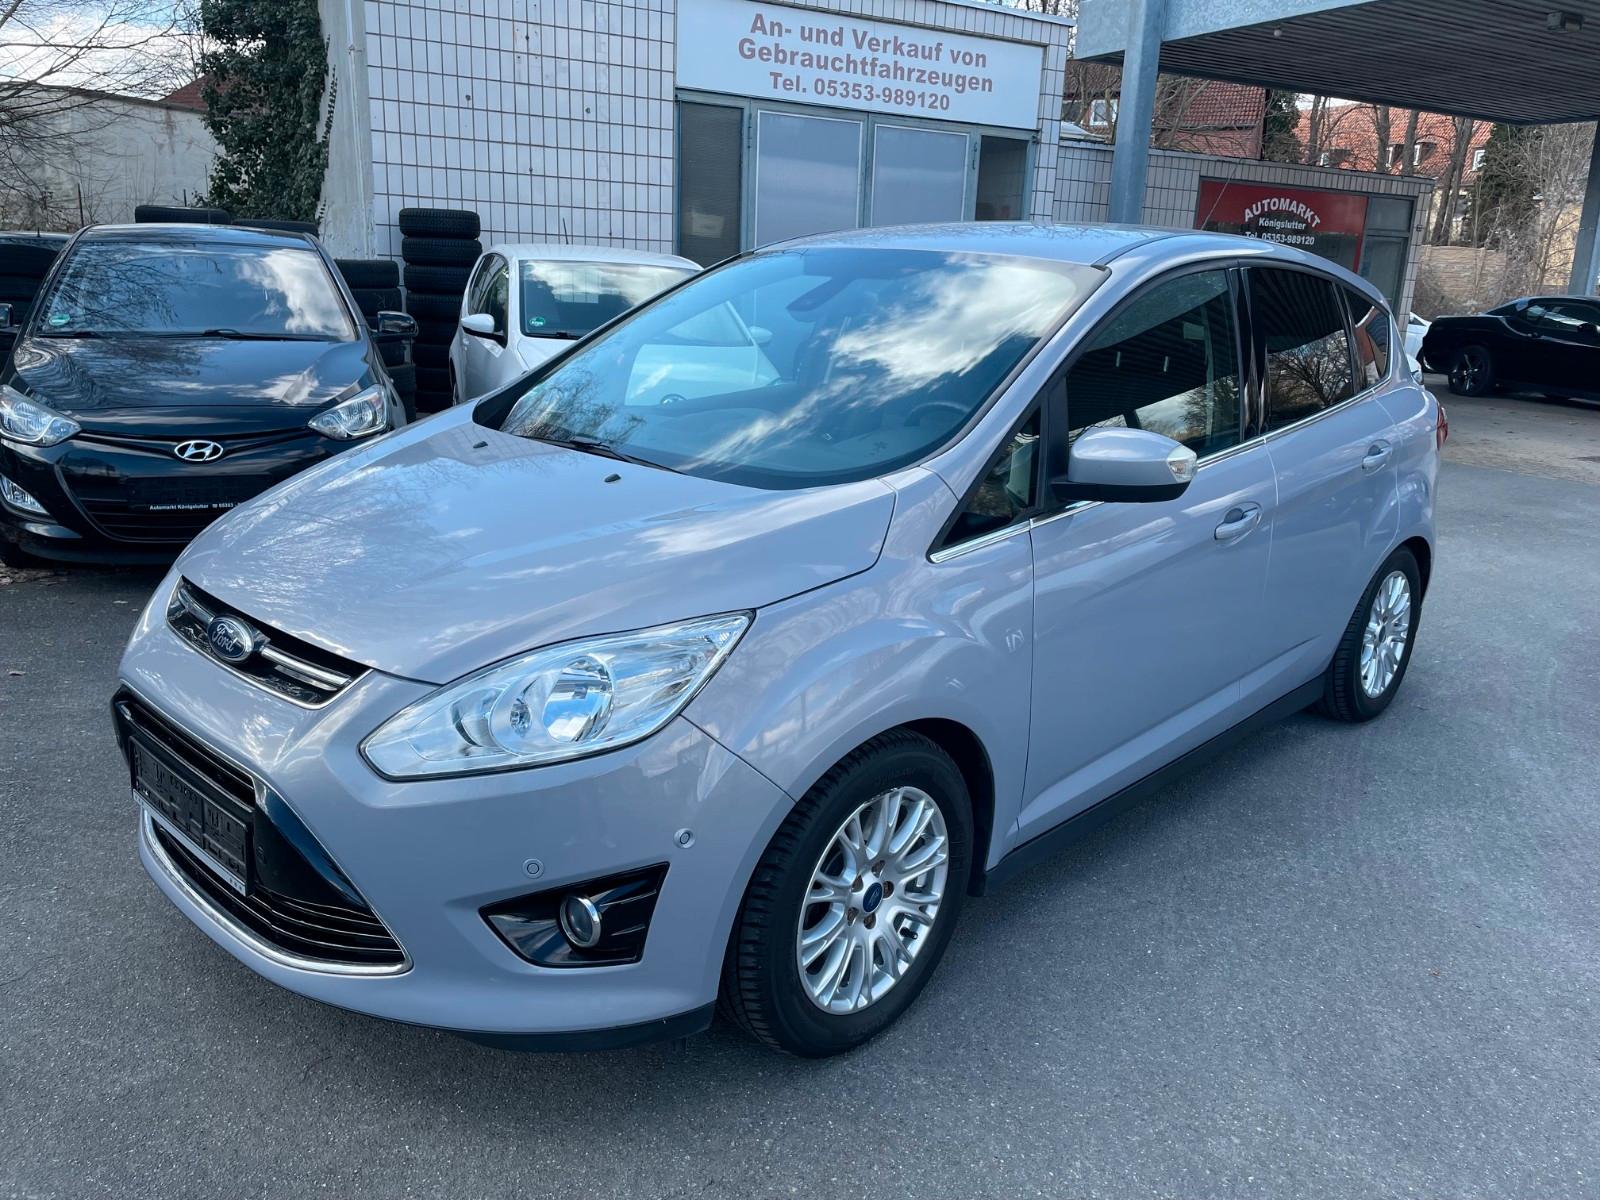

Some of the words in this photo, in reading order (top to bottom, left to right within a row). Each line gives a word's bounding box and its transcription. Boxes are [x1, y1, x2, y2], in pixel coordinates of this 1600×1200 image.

[750, 13, 792, 38] An-
[800, 26, 844, 47] und
[852, 29, 943, 62] Verkauf
[950, 49, 987, 68] von
[738, 37, 993, 94] Gebrauchtfahrzeugen
[769, 71, 807, 93] Tel.
[814, 78, 950, 111] 05353-989120
[1245, 197, 1320, 228] AUTOMARKT
[1259, 217, 1307, 230] Königslutter
[1261, 233, 1315, 245] 05353-989120
[212, 624, 238, 652] Ford
